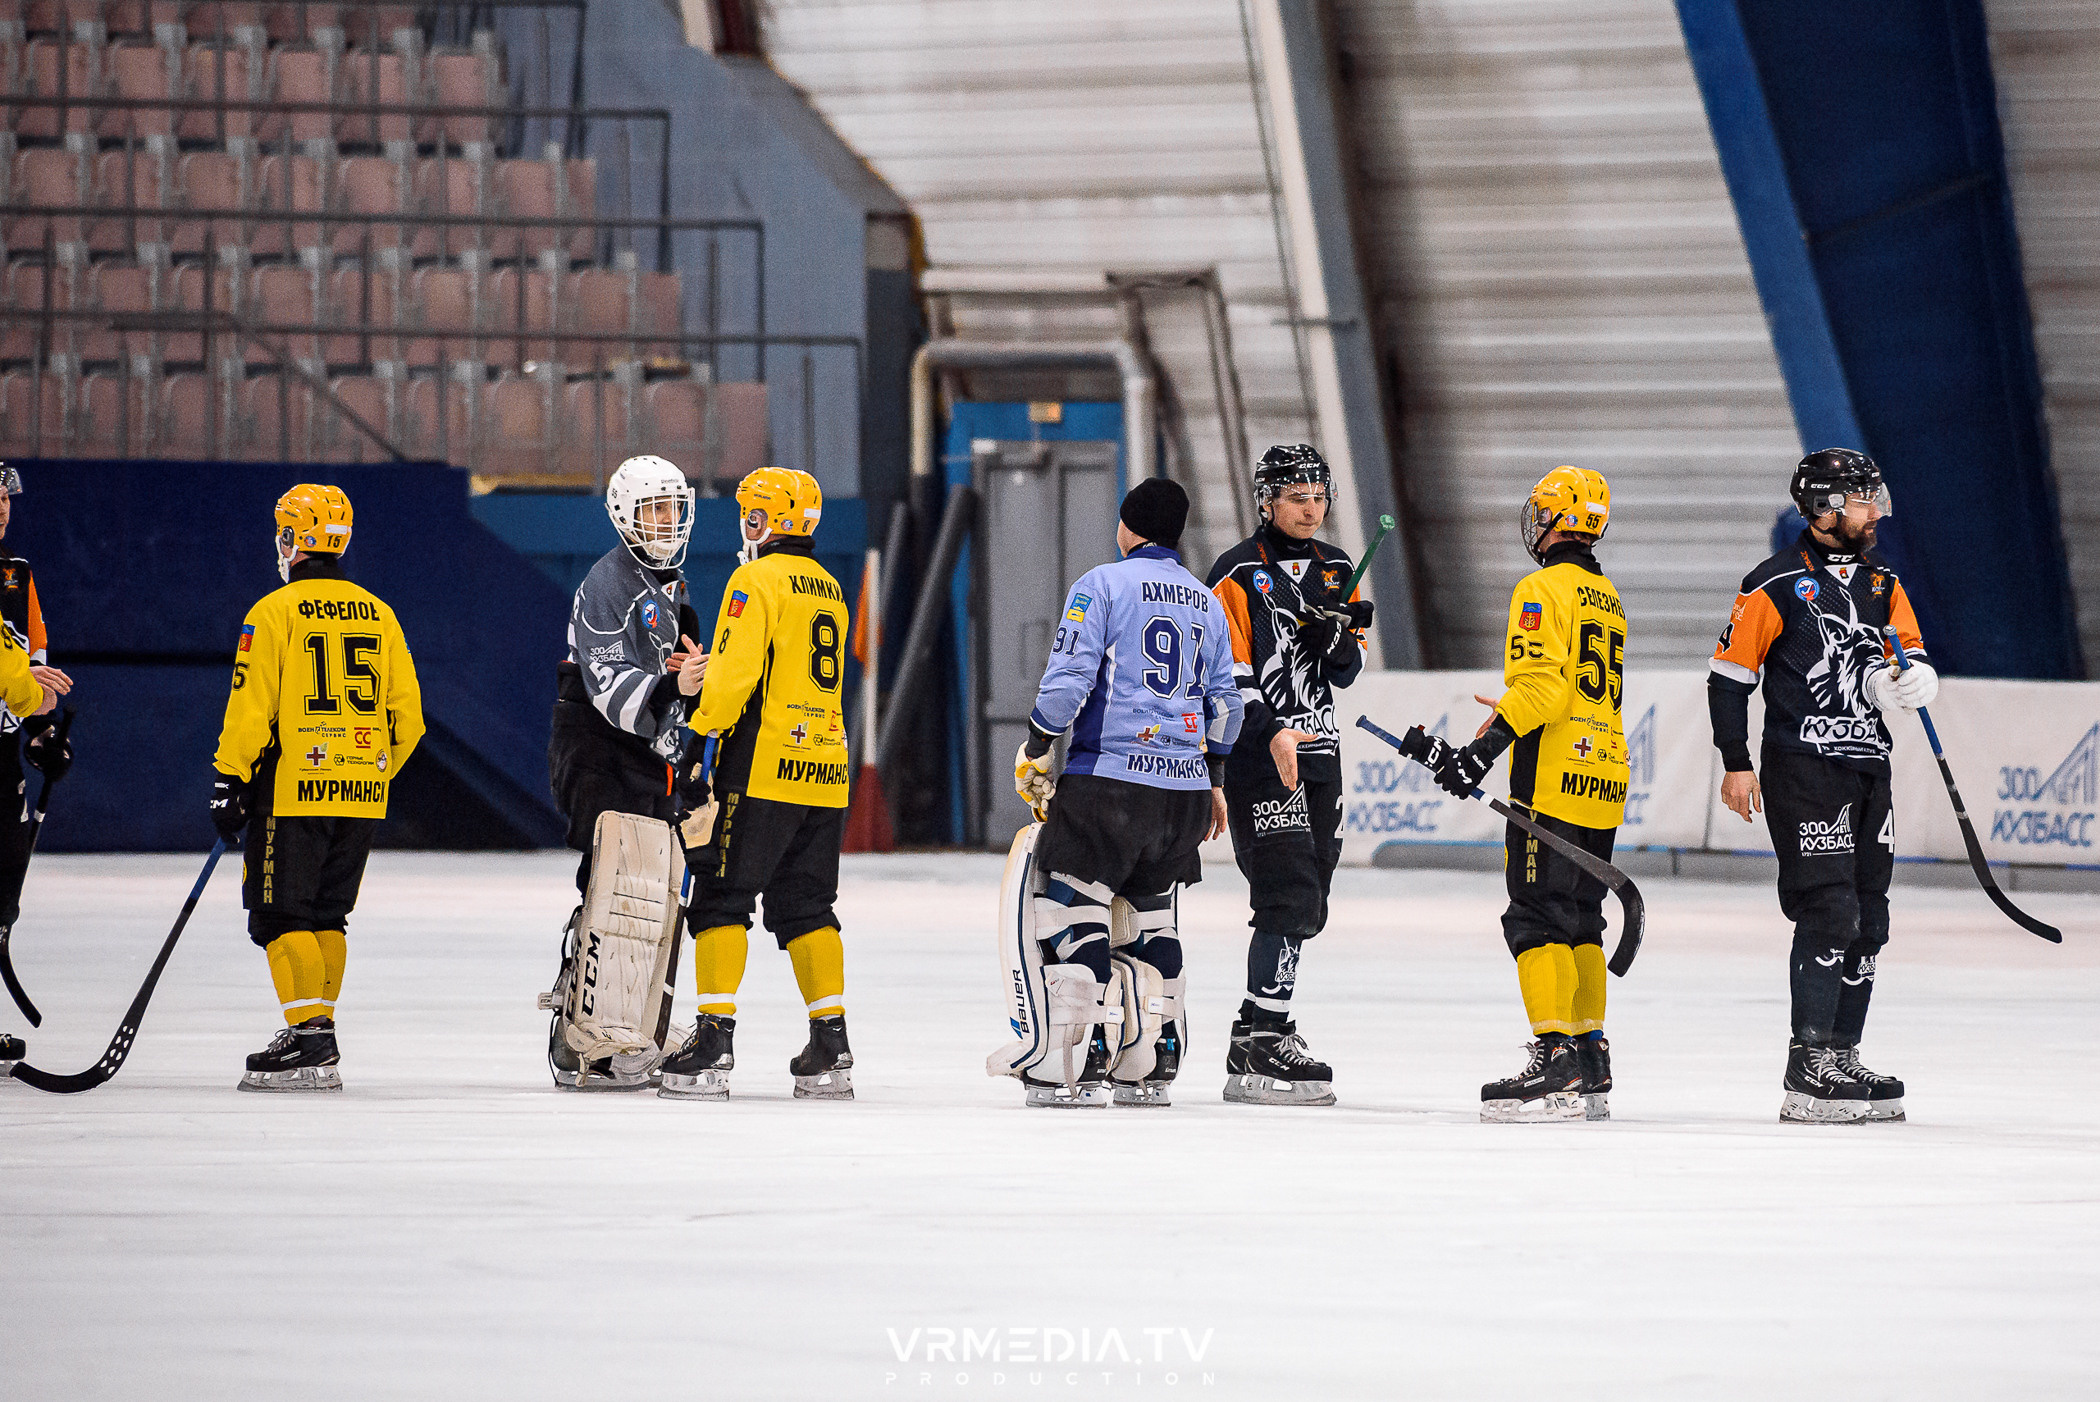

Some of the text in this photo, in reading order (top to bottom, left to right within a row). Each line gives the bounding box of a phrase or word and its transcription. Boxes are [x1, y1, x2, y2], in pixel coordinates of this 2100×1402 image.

[801, 519, 811, 533] 8
[1585, 513, 1602, 529] 55
[327, 535, 342, 548] 15
[1141, 580, 1209, 614] АХМЕРОВ
[717, 626, 732, 656] 8
[808, 608, 841, 694] 8
[1051, 625, 1082, 658] 91
[1718, 621, 1734, 654] 4
[303, 631, 382, 716] 15
[1141, 615, 1206, 700] 91
[1575, 618, 1625, 716] 55
[1252, 799, 1281, 817] 300
[1799, 821, 1828, 836] 300
[1877, 808, 1895, 854] 4
[582, 931, 601, 1017] CCM
